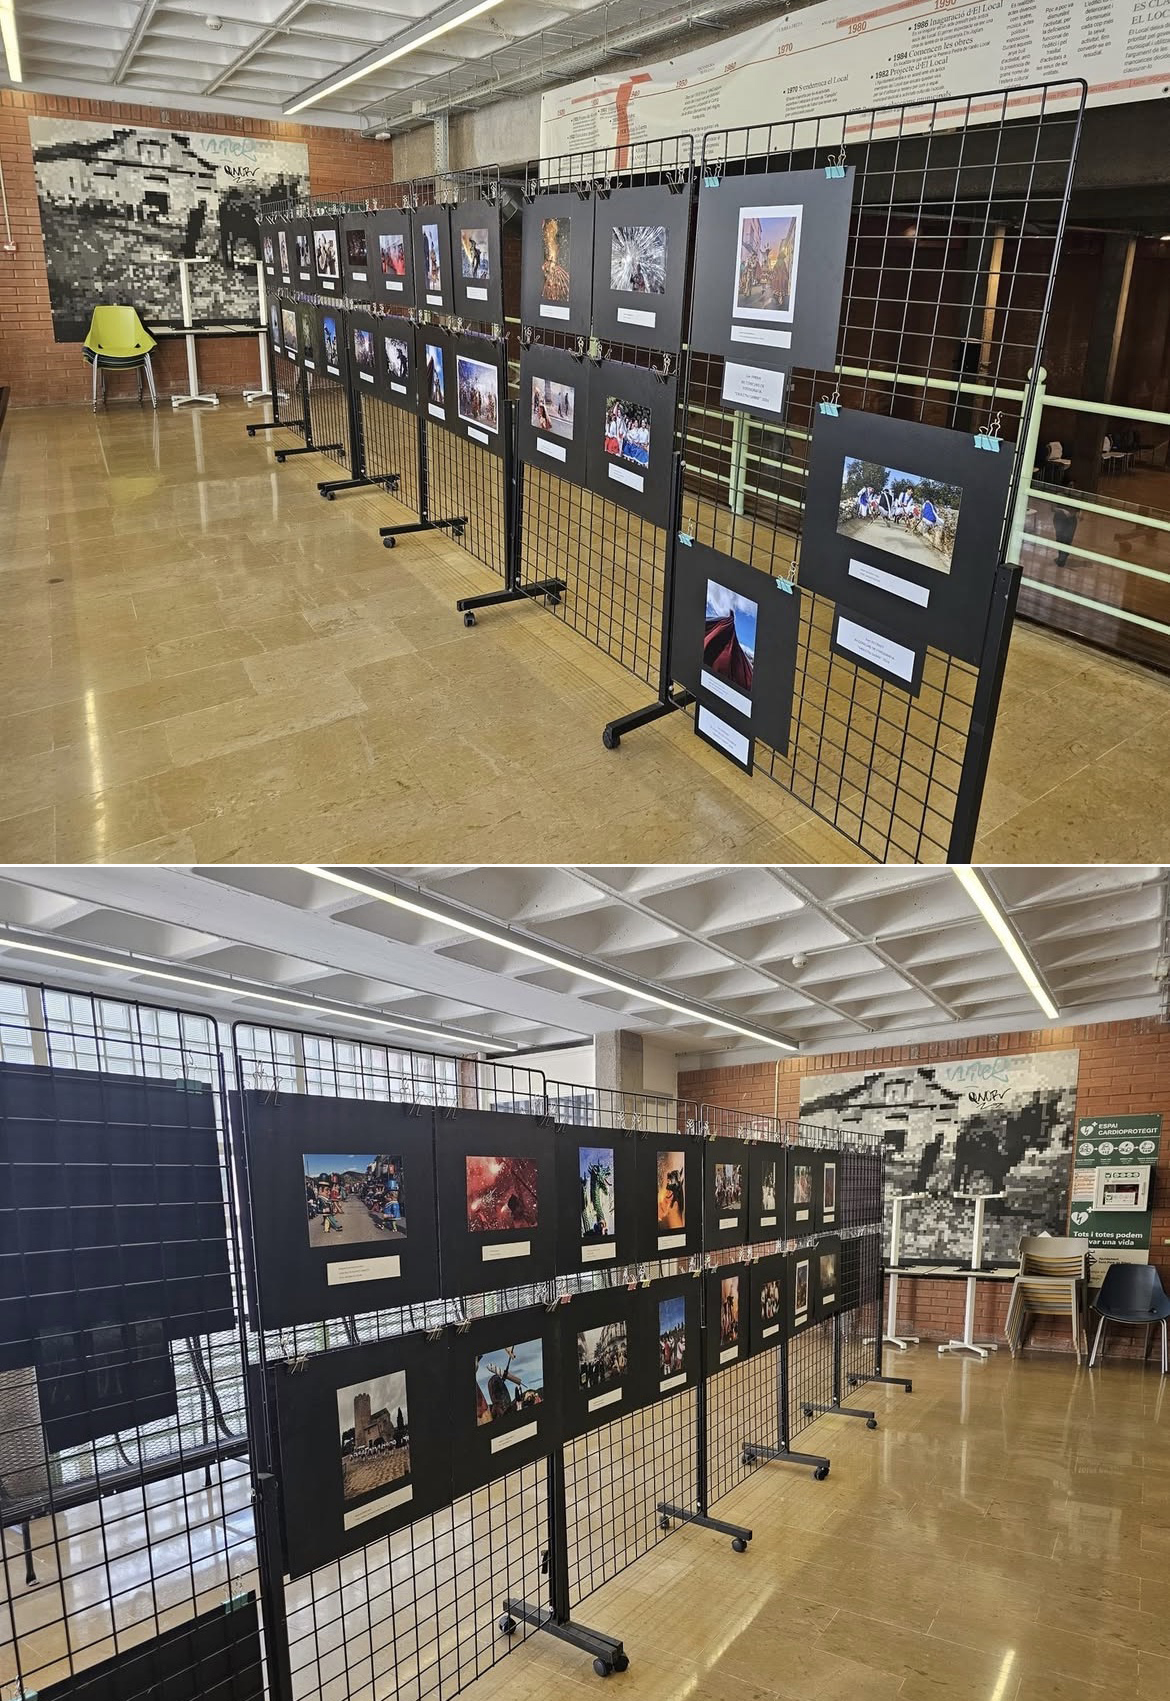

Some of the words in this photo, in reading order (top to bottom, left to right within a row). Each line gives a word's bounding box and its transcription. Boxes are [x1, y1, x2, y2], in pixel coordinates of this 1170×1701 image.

[1134, 1, 1146, 12] ES
[914, 20, 928, 30] 1986
[982, 0, 1002, 12] Local
[1132, 14, 1145, 25] EL
[848, 21, 868, 34] 1980
[777, 42, 794, 54] 1970
[893, 52, 908, 61] 1984
[909, 45, 942, 58] Comencen
[943, 41, 952, 49] les
[954, 37, 973, 46] obres
[875, 70, 889, 79] 1982
[930, 56, 948, 67] Local
[833, 74, 849, 83] Local
[1098, 1128, 1158, 1136] CARDIOPROTEGIT
